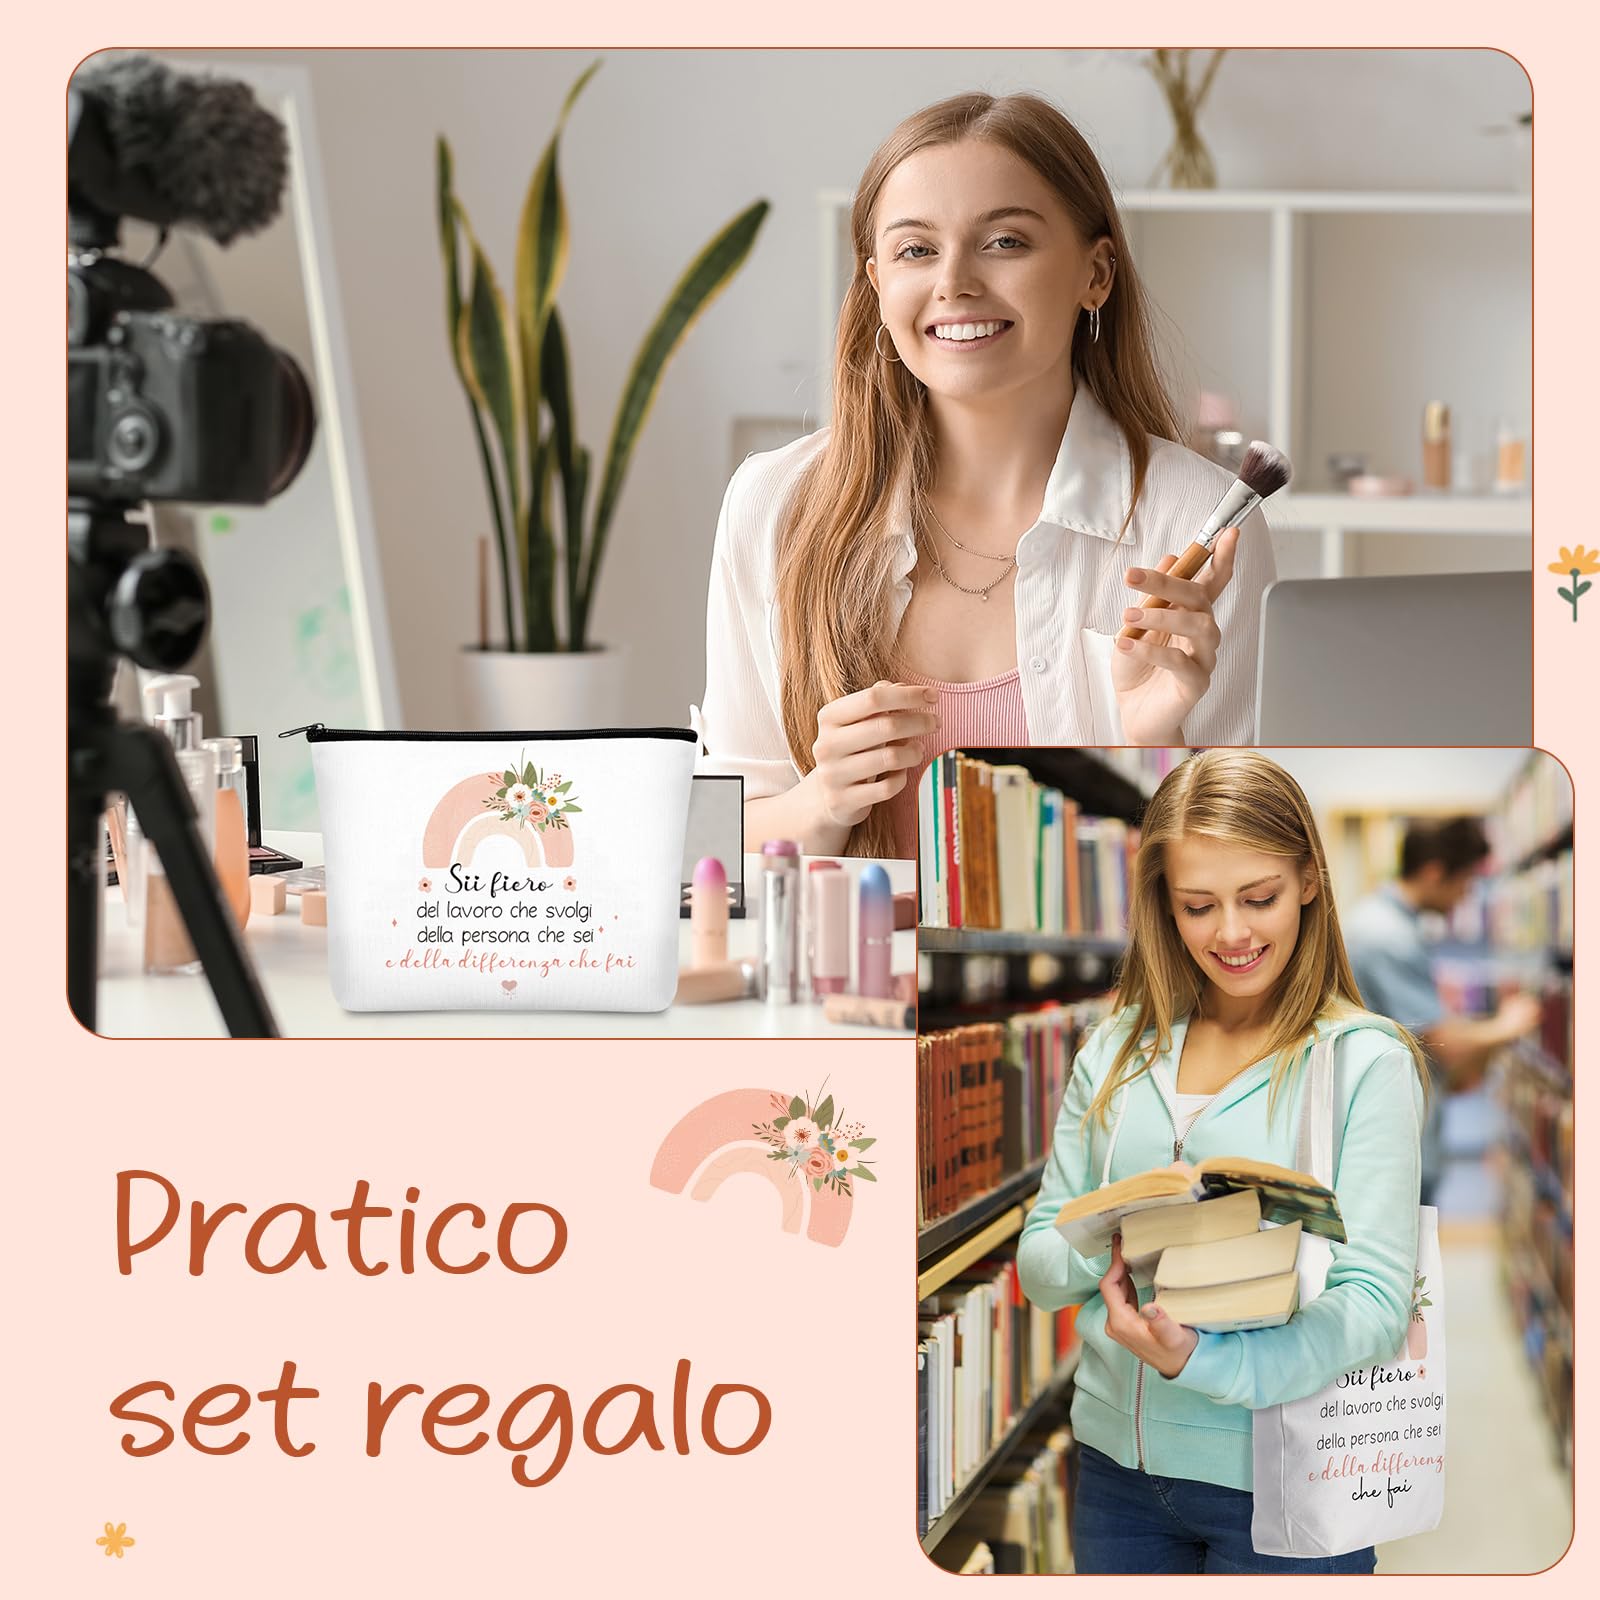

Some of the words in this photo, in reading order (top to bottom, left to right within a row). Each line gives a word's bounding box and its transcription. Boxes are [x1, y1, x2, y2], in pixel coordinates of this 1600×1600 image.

[445, 863, 486, 894] Sii
[490, 871, 554, 898] fiero
[416, 901, 439, 919] del
[447, 901, 503, 919] lavoro
[510, 901, 538, 919] che
[545, 901, 593, 923] svolgi
[417, 926, 454, 943] della
[462, 929, 530, 946] persona
[537, 926, 566, 944] che
[573, 927, 595, 943] sei
[385, 959, 398, 968] e
[400, 949, 455, 969] della
[458, 949, 567, 978] differenza
[569, 949, 603, 969] che
[605, 952, 639, 973] fai
[1370, 1365, 1416, 1391] fiero
[1320, 1400, 1339, 1419] del
[1342, 1399, 1383, 1416] lavoro
[1386, 1395, 1407, 1412] che
[1410, 1392, 1445, 1411] svolgi
[1316, 1431, 1346, 1451] della
[1350, 1429, 1400, 1450] persona
[1403, 1424, 1423, 1441] che
[1426, 1424, 1442, 1437] sei
[1308, 1471, 1320, 1482] e
[1321, 1455, 1370, 1481] della
[1371, 1450, 1445, 1476] differenz
[1351, 1476, 1382, 1501] che
[1387, 1477, 1413, 1509] fai
